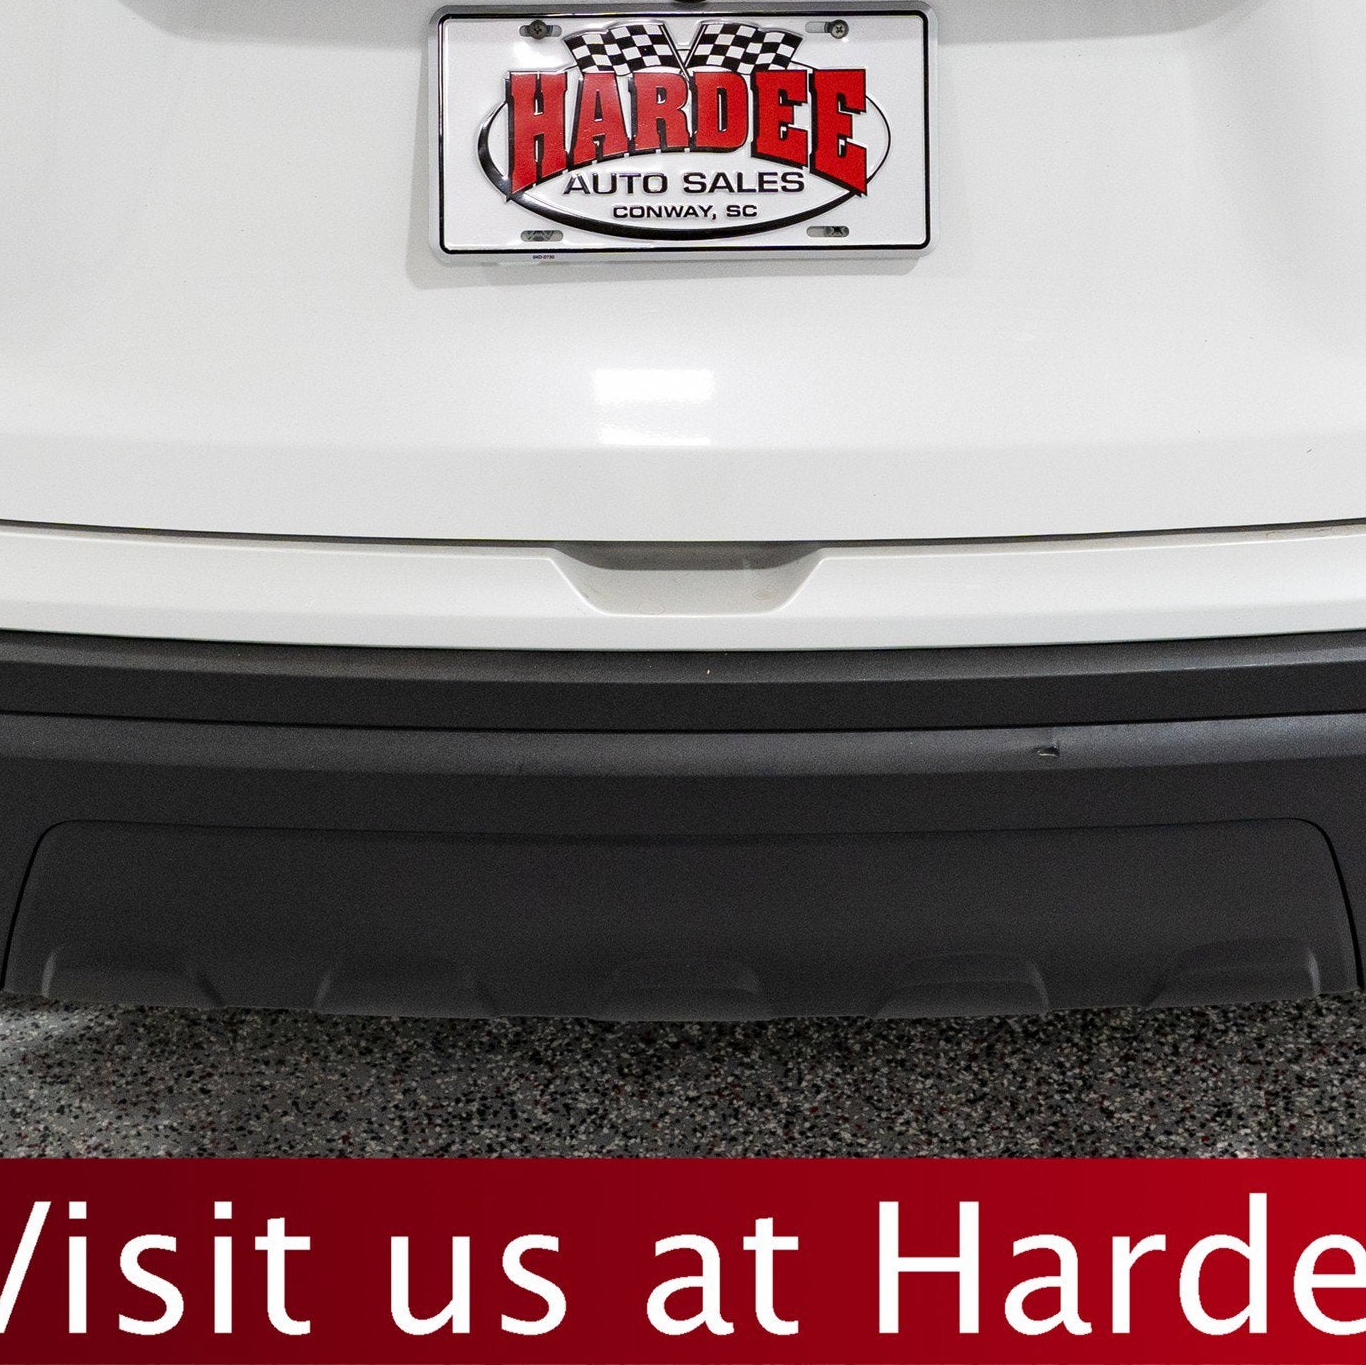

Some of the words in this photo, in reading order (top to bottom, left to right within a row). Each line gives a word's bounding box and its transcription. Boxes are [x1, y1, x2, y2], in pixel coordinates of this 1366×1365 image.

[504, 69, 869, 201] HARDEE
[562, 171, 671, 196] AUTO
[682, 170, 806, 194] SALES
[612, 204, 718, 221] CONWAY,
[725, 204, 759, 219] SC
